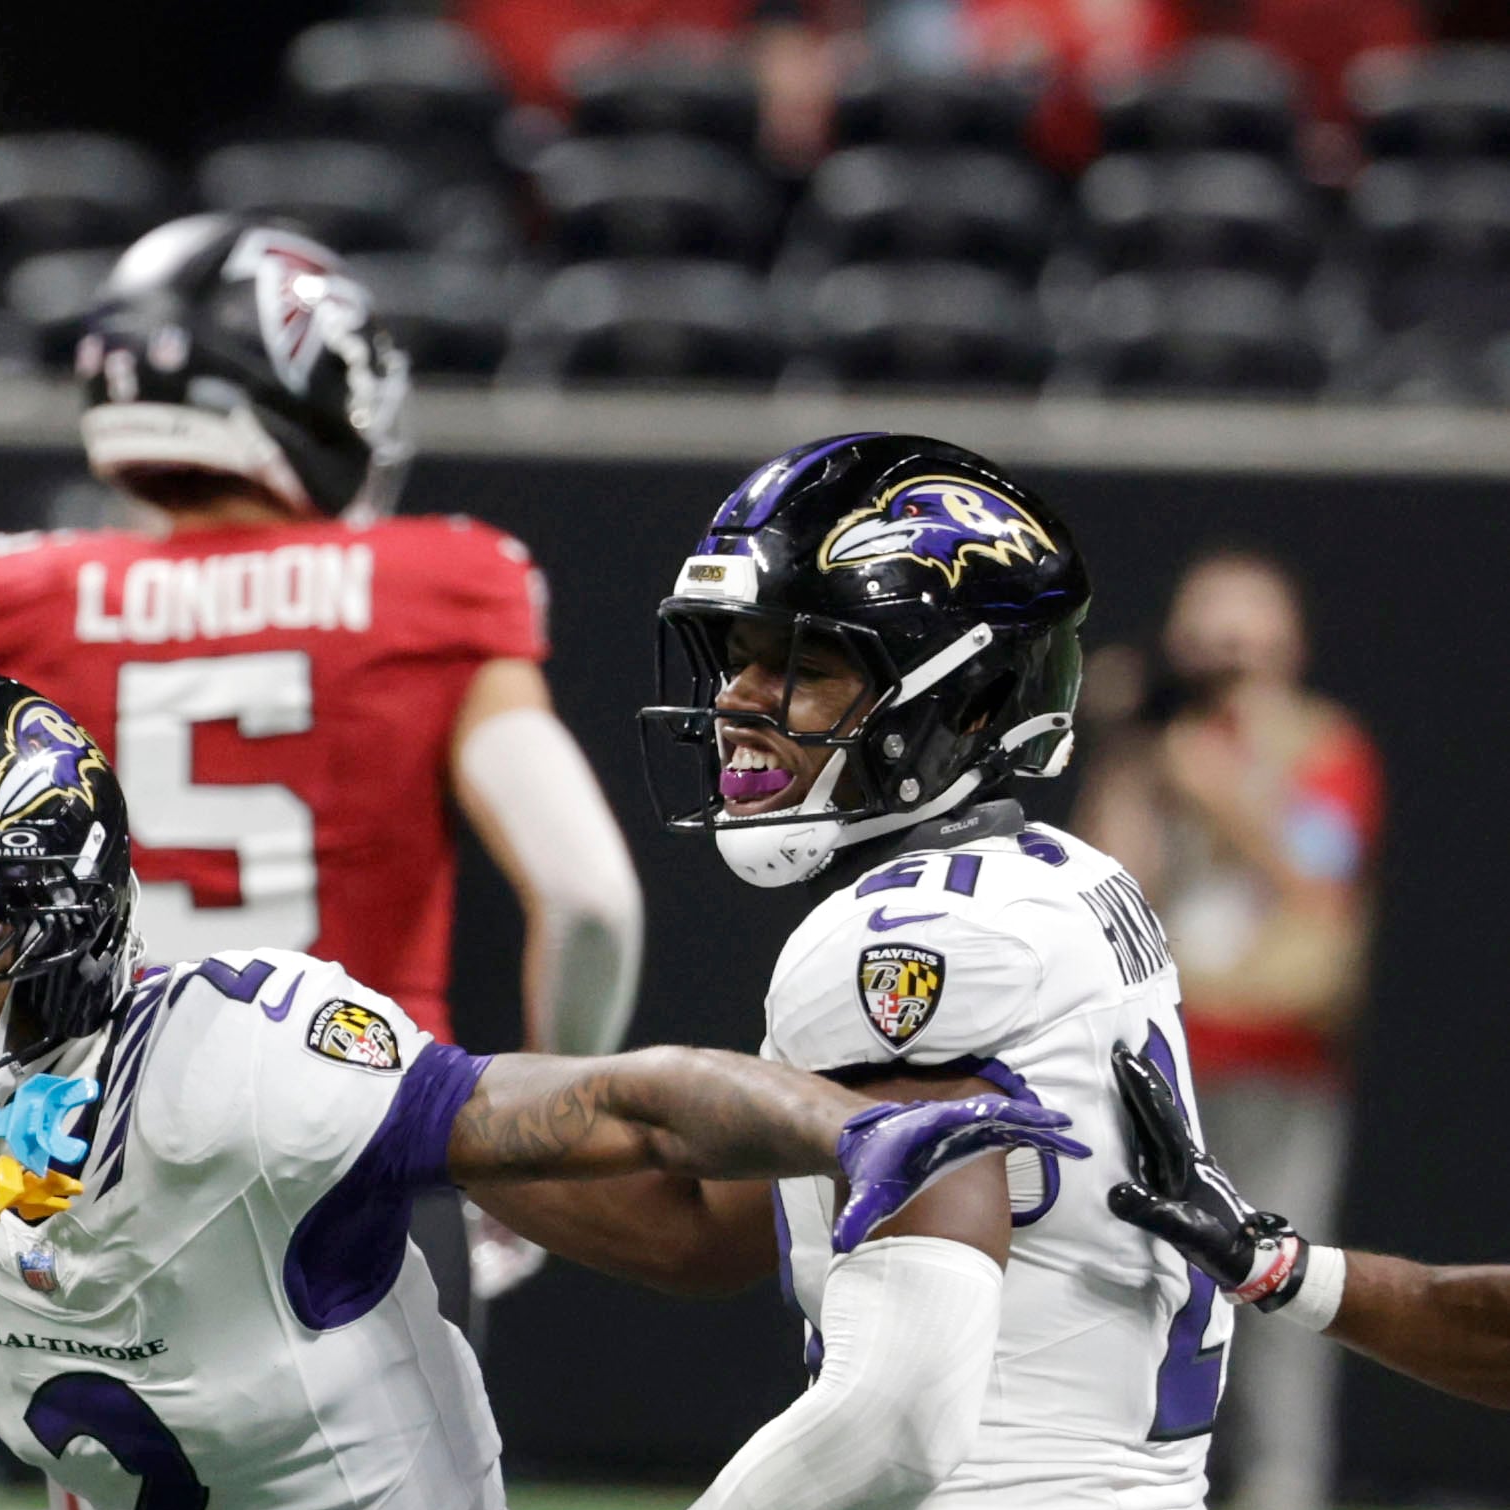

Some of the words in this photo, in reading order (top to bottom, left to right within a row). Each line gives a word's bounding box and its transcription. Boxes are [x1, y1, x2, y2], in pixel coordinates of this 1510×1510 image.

[76, 544, 371, 643] LONDON
[116, 650, 320, 958] 5
[866, 948, 939, 967] RAVENS
[309, 1000, 345, 1047] RAVENS
